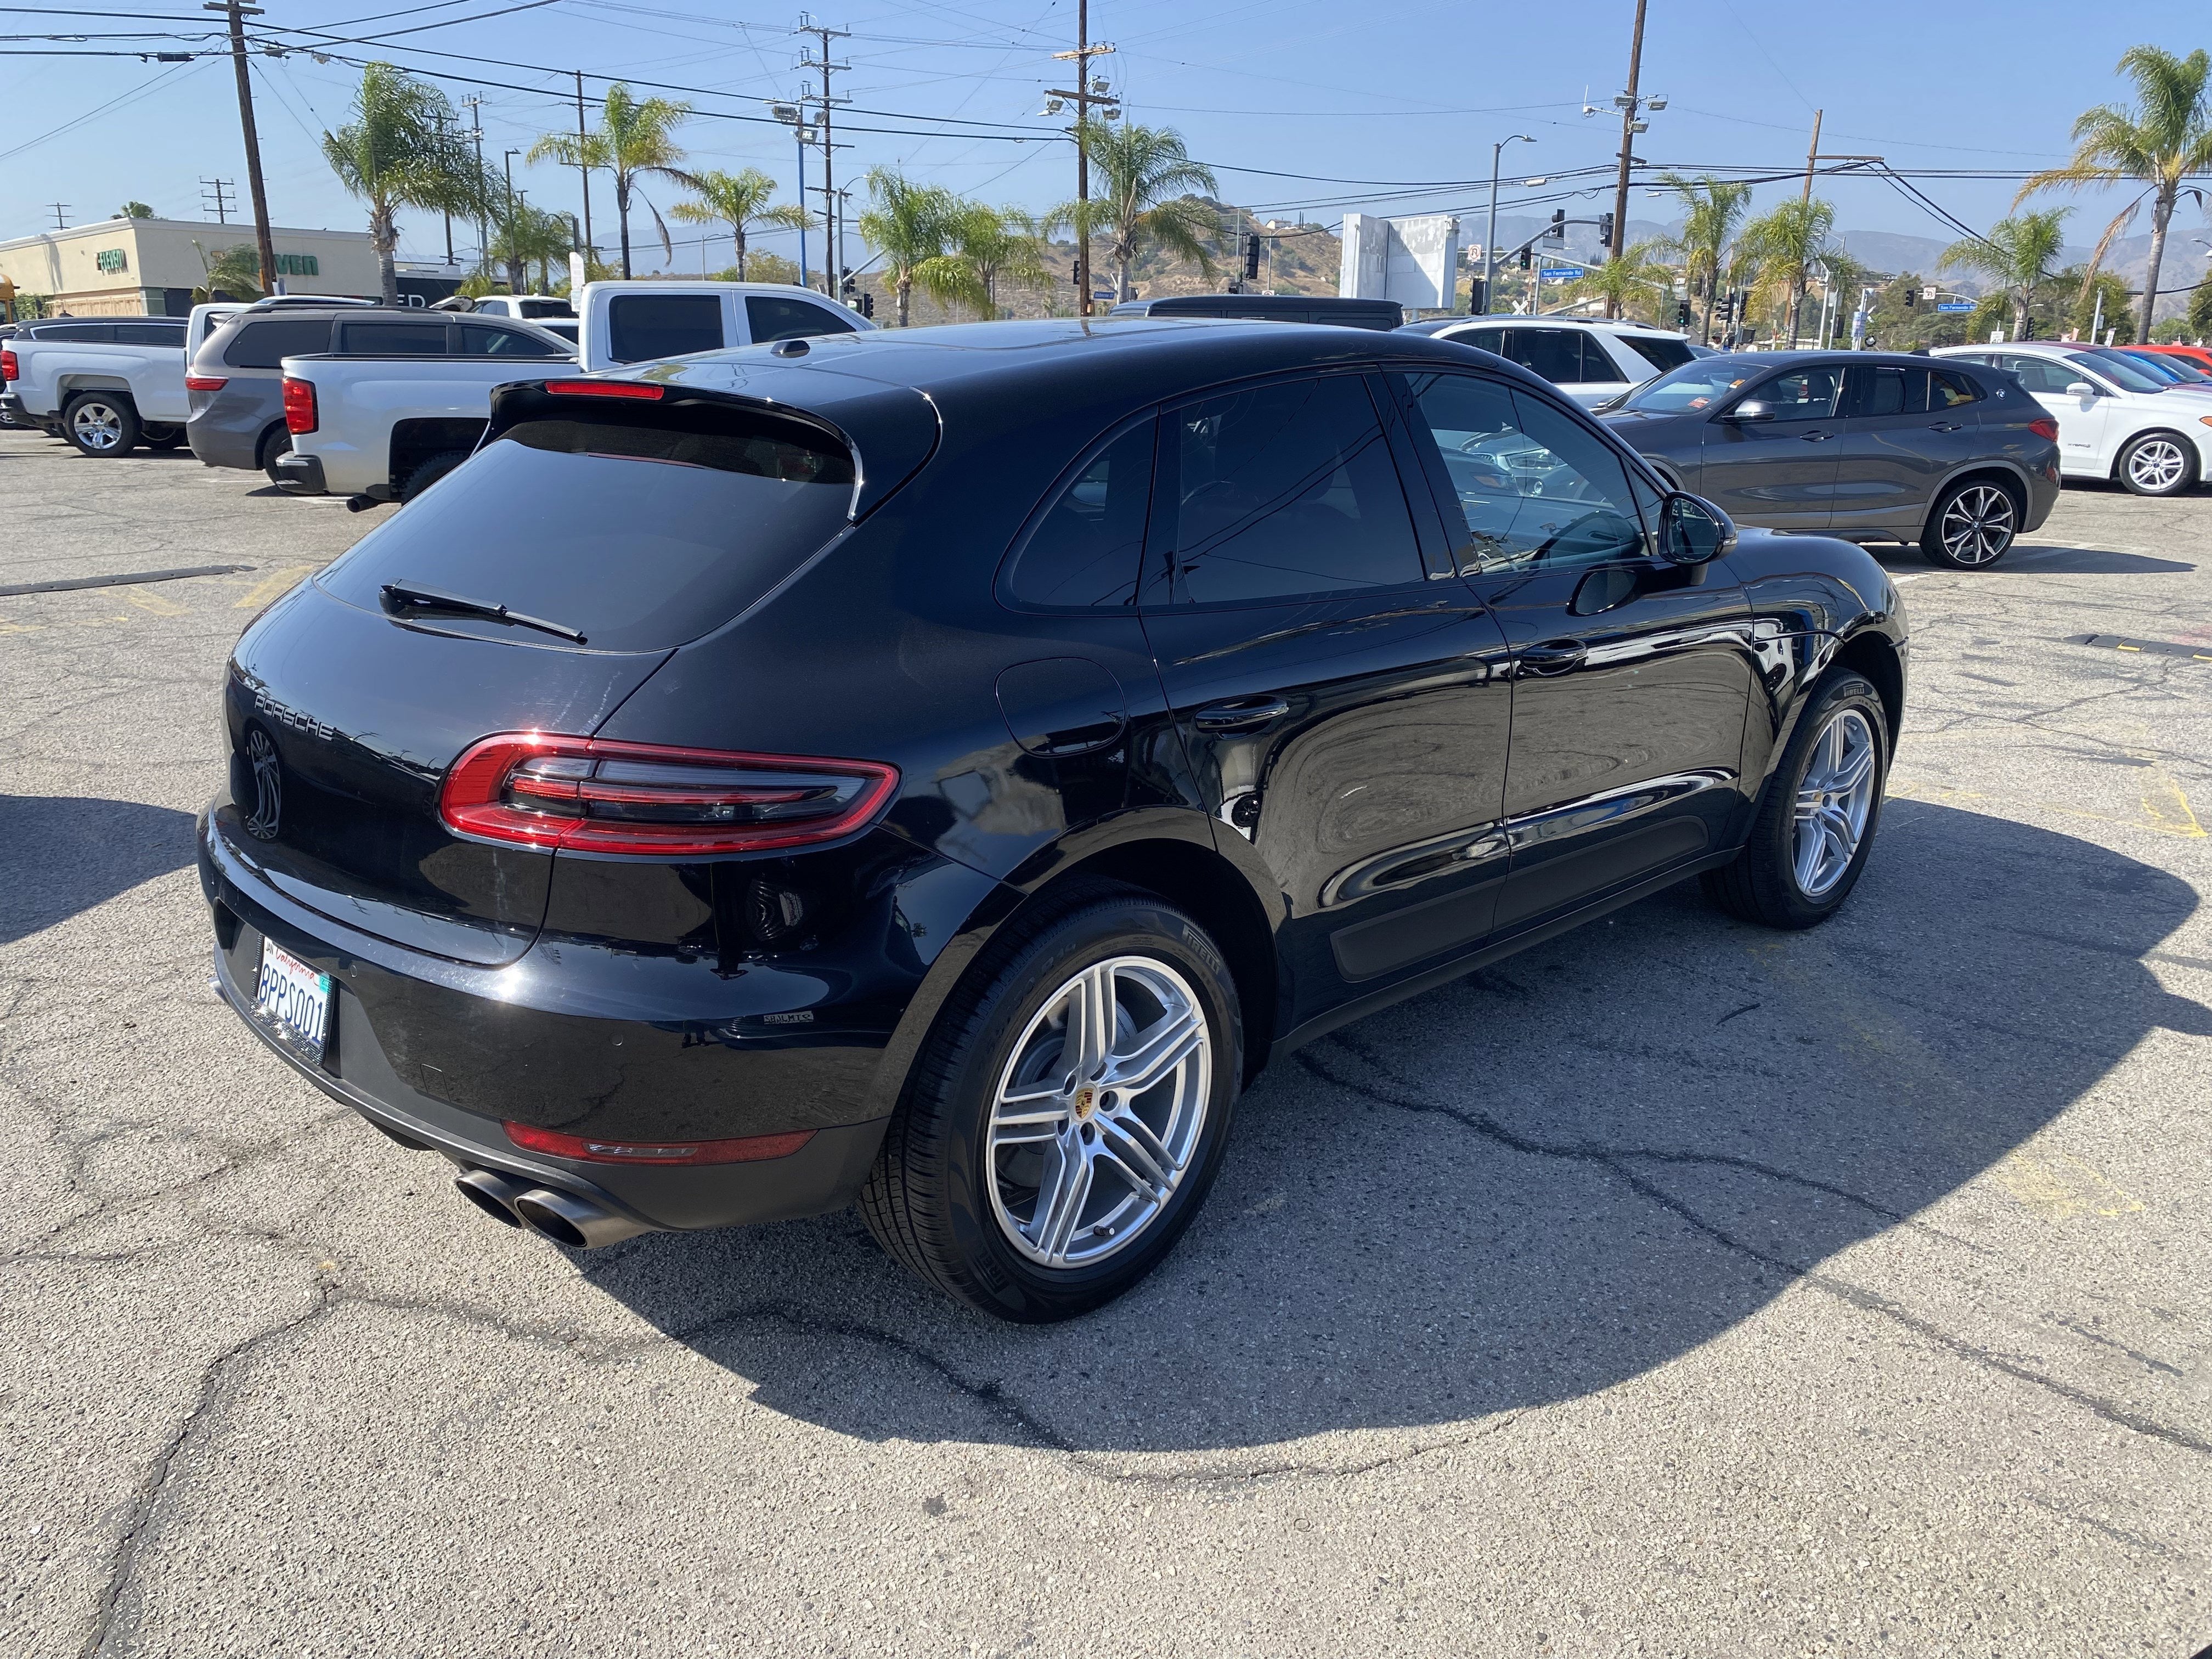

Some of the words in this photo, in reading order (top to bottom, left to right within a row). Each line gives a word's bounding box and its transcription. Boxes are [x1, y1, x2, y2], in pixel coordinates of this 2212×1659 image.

[1843, 683, 1865, 697] PIRELLI
[254, 695, 335, 741] PORSCHE
[276, 947, 319, 987] California
[1182, 924, 1221, 975] PIRELLI
[259, 963, 323, 1045] 8PPS001
